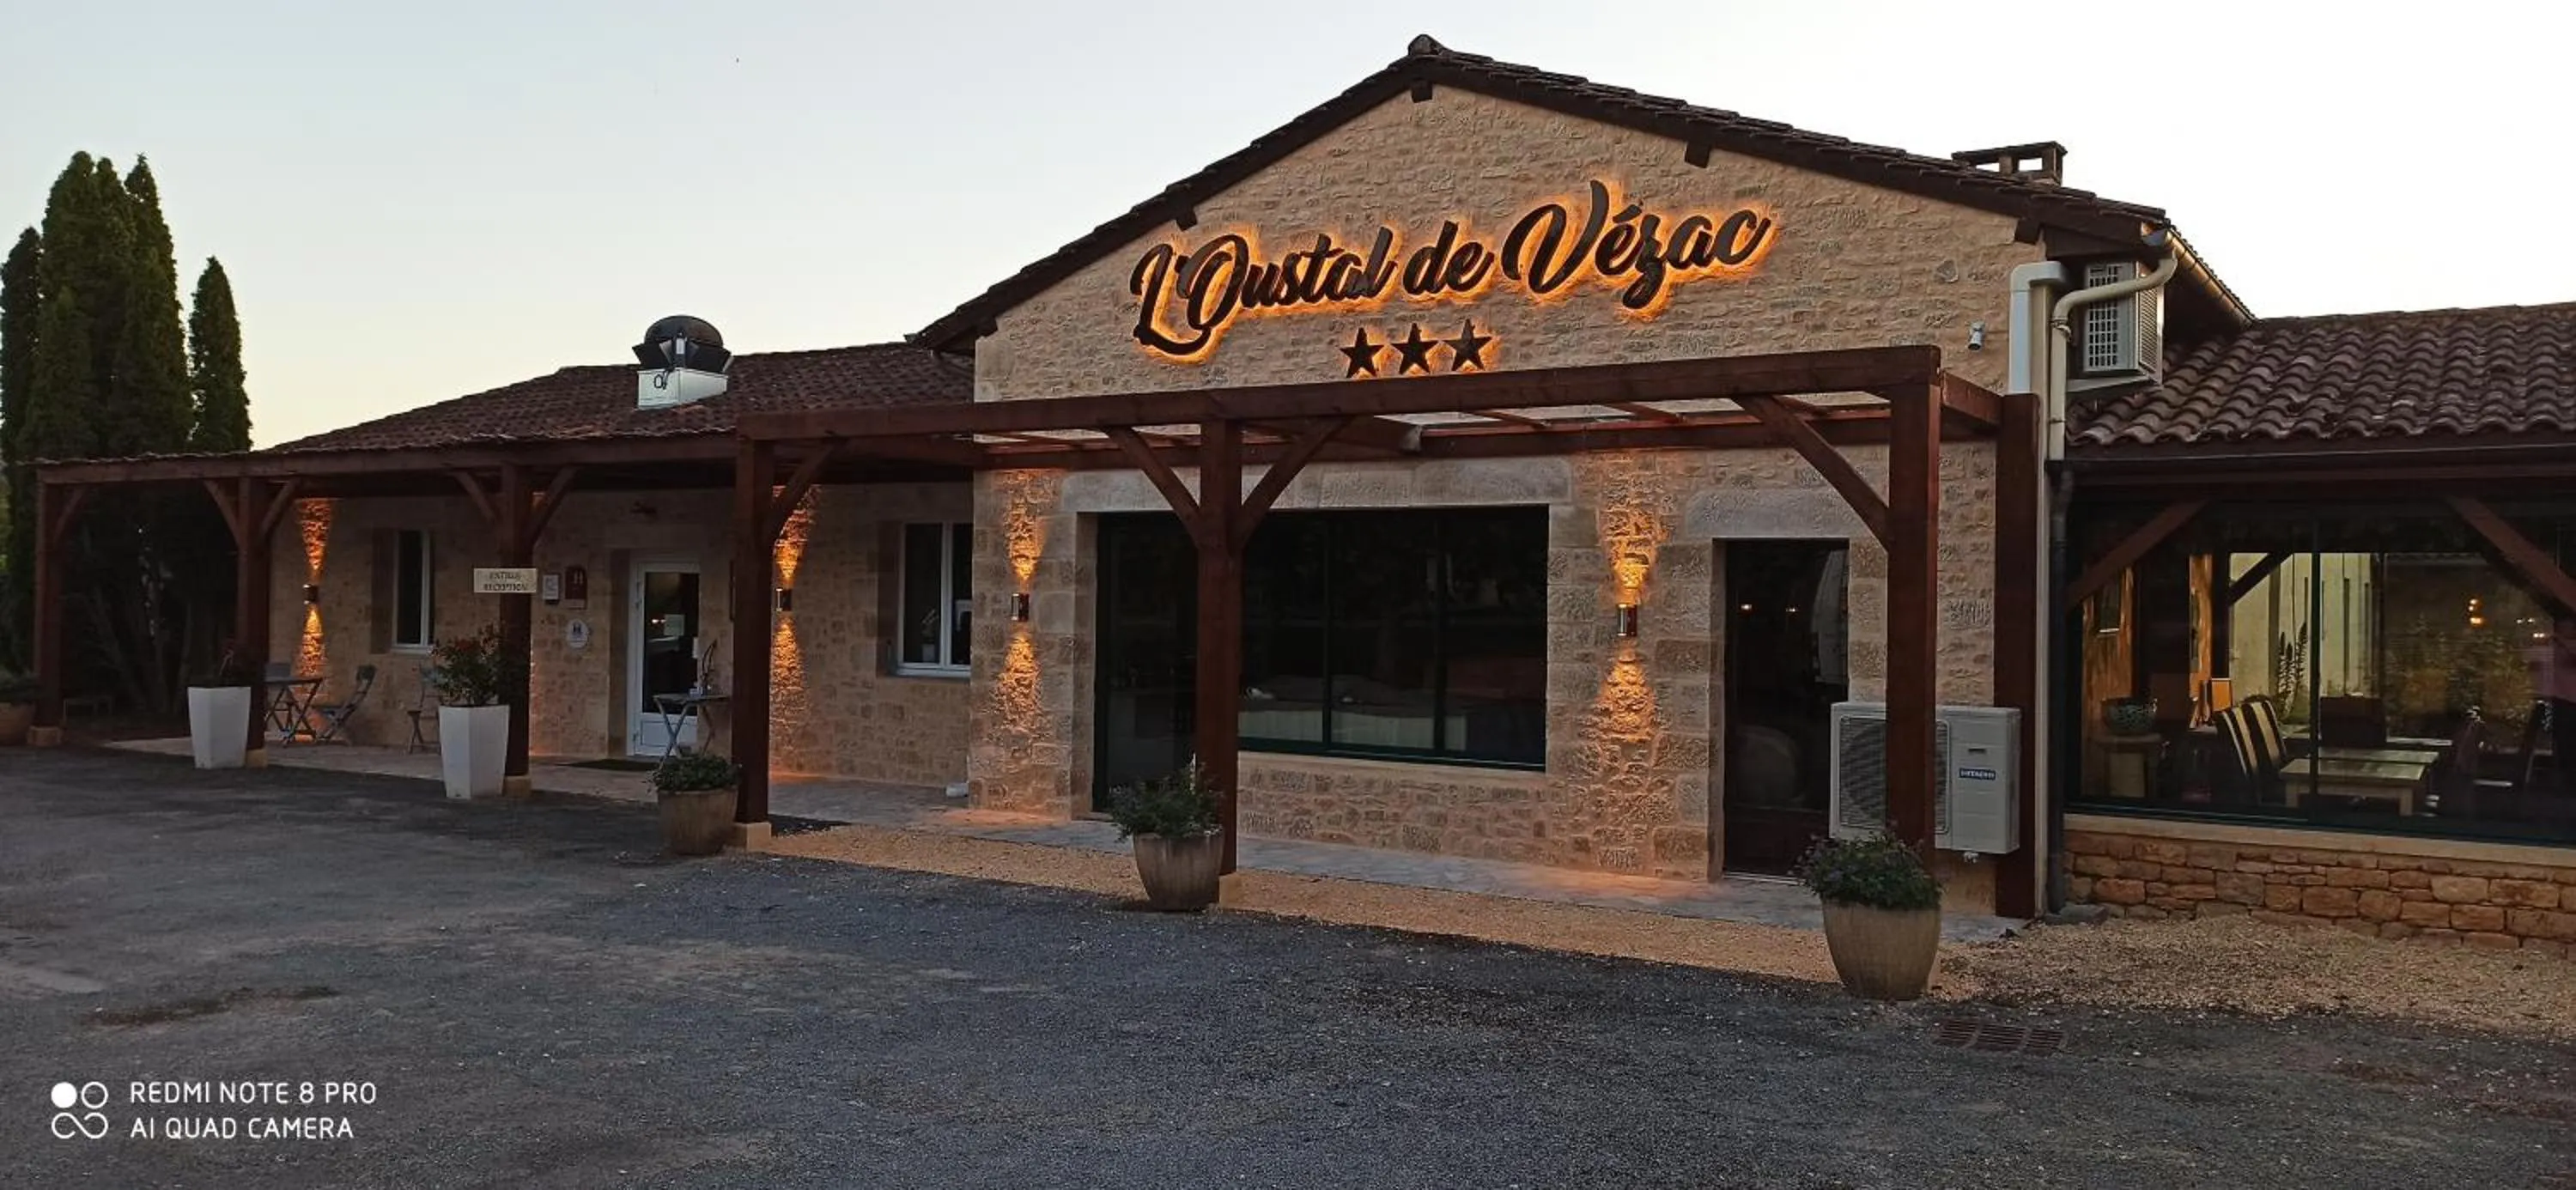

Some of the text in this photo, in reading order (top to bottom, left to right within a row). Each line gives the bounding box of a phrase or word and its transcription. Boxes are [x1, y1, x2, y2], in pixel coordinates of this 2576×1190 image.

[1129, 179, 1771, 355] L'Oustal de Vézac
